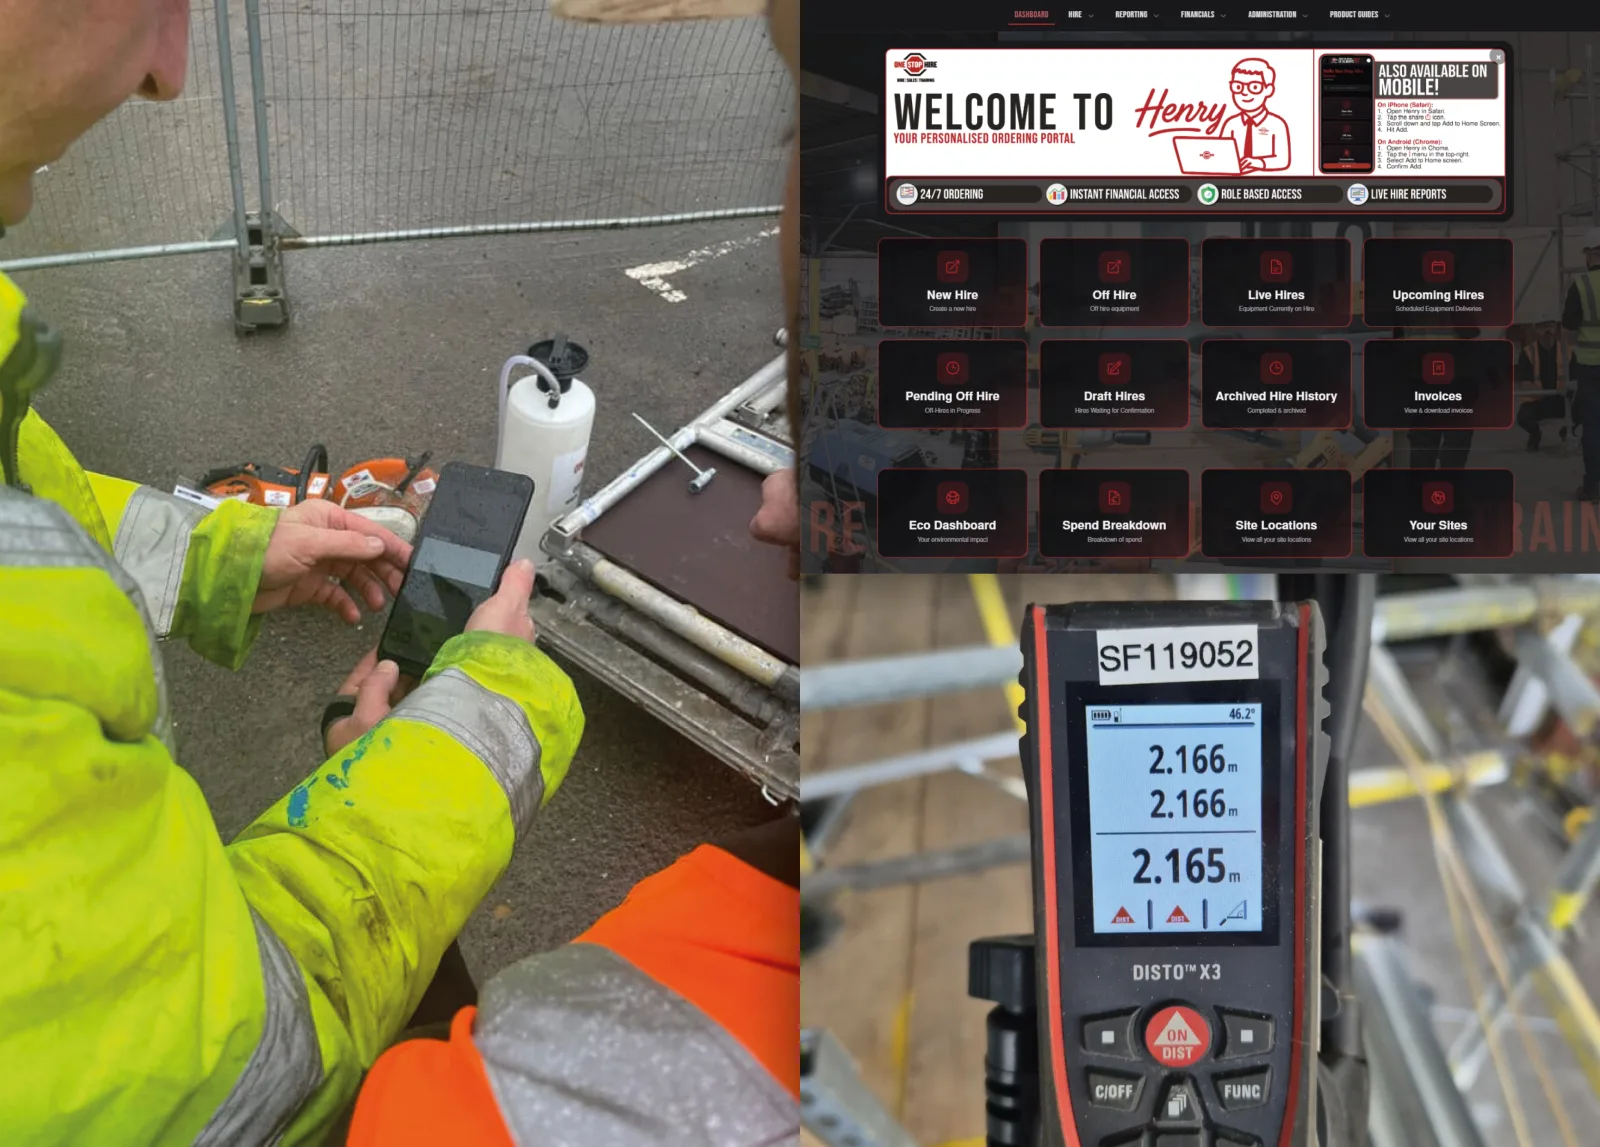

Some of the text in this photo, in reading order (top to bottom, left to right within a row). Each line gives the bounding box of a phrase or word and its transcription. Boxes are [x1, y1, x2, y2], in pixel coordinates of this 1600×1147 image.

[1379, 64, 1406, 77] ALSO
[1410, 64, 1468, 77] AVAILABLE
[1472, 64, 1487, 77] ON
[1379, 78, 1438, 95] MOBILE!
[894, 93, 1113, 130] WELCOME TO
[1135, 88, 1226, 134] Henry
[894, 133, 1075, 144] YOUR PERSONALISED ORDERING PORTAL
[921, 189, 983, 199] 24/7 ORDERING
[1070, 189, 1179, 199] INSTANT FINANCIAL ACCESS
[1222, 189, 1302, 199] ROLE BASED ACCESS
[1371, 189, 1446, 199] LIVE HIRE REPORTS
[927, 290, 978, 299] New Hire
[1093, 290, 1136, 300] Off Hire
[1248, 290, 1305, 299] Live Hires
[1393, 290, 1484, 302] Upcoming Hires
[906, 391, 1000, 403] Pending Off Hire
[1084, 391, 1145, 400] Draft Hires
[1216, 392, 1337, 403] Archived Hire History
[1415, 391, 1462, 400] Invoices
[910, 520, 996, 530] Eco Dashboard
[1063, 520, 1166, 532] Spend Breakdown
[1236, 520, 1317, 530] Site Locations
[1410, 520, 1467, 530] Your Sites
[1100, 640, 1253, 672] SF119052
[1229, 708, 1255, 720] 46.2°
[1149, 744, 1238, 774] 2.166 m
[1150, 789, 1238, 818] 2.166 m
[1132, 848, 1240, 884] 2.165 m
[1200, 964, 1221, 980] X3
[1167, 1030, 1188, 1041] ON
[1162, 1047, 1193, 1060] DIST
[1096, 1085, 1132, 1098] C/OFF
[1224, 1085, 1261, 1098] FUNC
